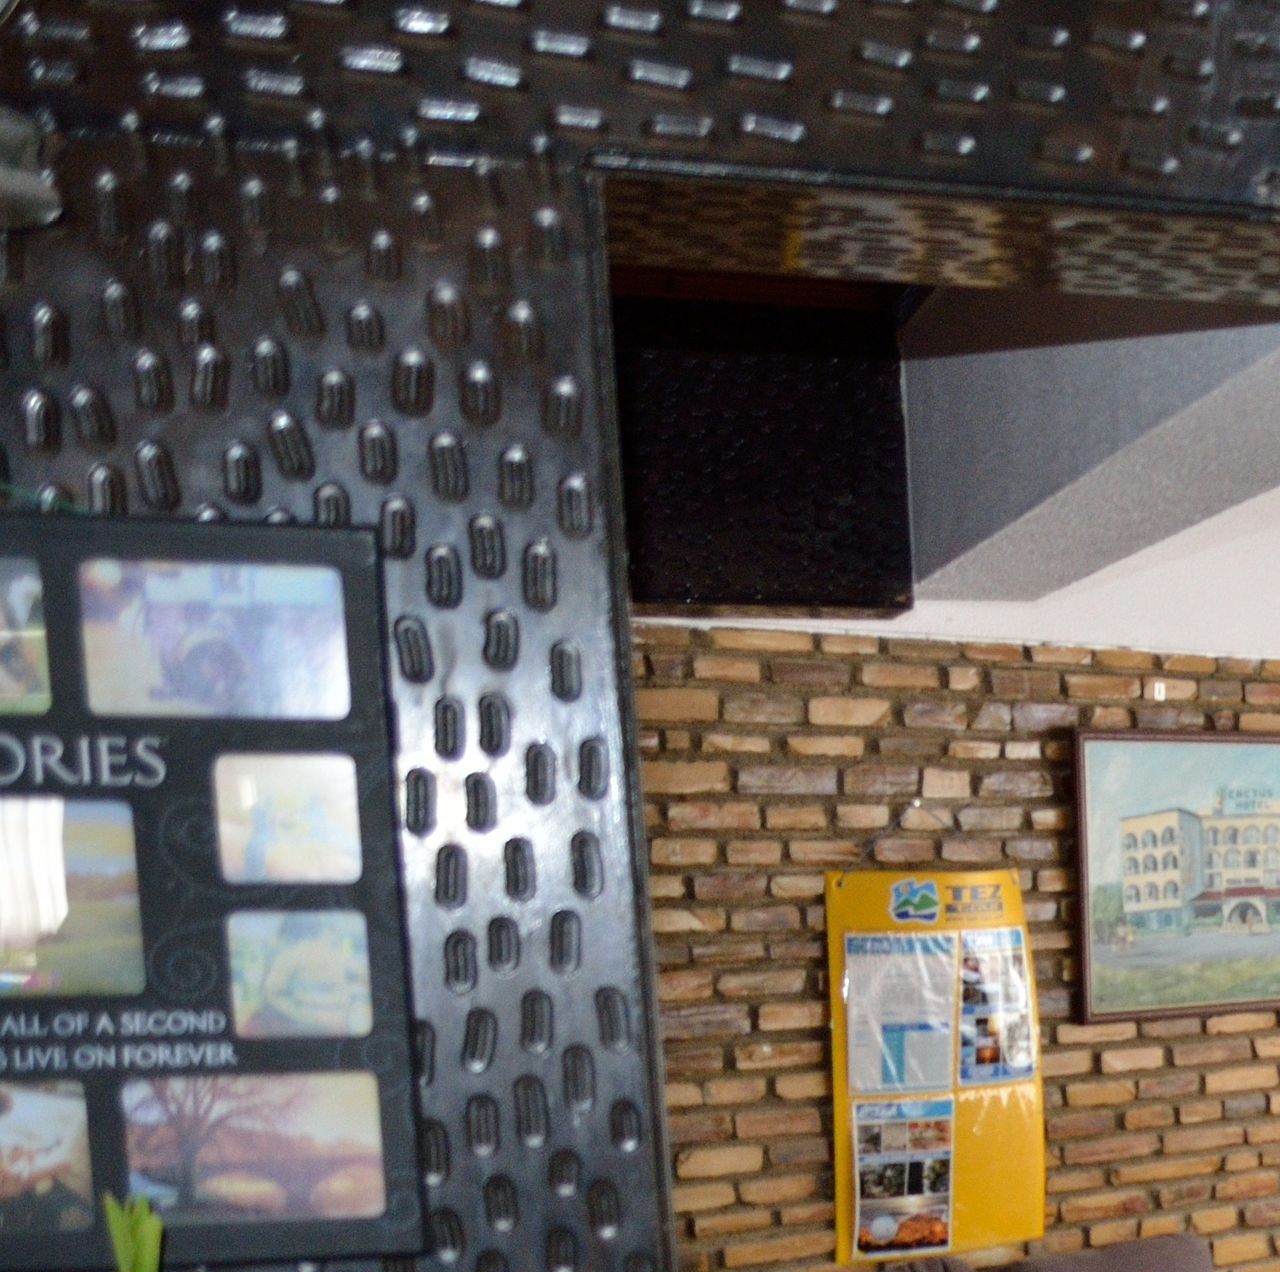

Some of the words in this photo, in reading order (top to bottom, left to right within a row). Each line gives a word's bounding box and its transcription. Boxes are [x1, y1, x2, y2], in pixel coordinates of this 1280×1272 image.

[53, 1010, 90, 1037] OF
[96, 1011, 115, 1036] A
[120, 1009, 227, 1036] SECOND
[14, 1045, 68, 1071] LIVE
[74, 1043, 117, 1070] ON
[123, 1041, 239, 1068] FOREVER
